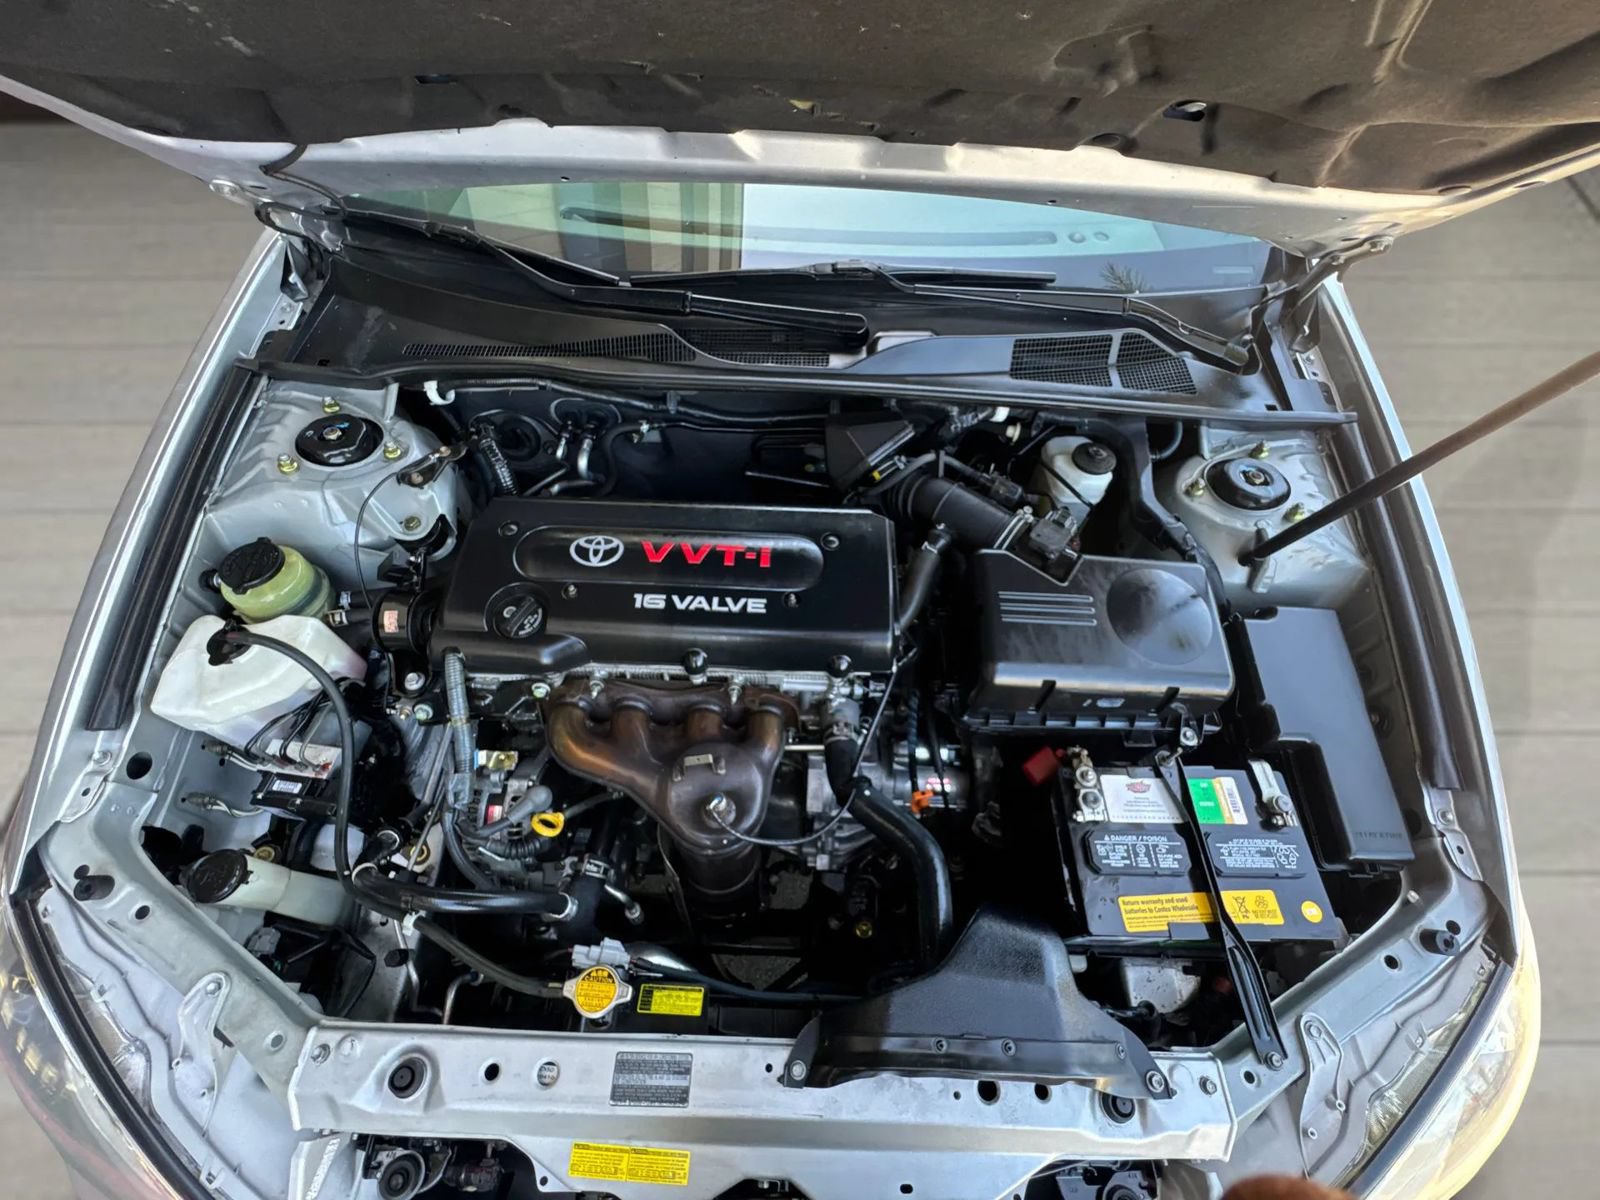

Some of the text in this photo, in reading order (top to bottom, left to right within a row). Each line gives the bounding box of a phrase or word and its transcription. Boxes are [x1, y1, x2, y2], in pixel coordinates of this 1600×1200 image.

[633, 592, 768, 614] 16 VALVE
[1165, 896, 1175, 904] and
